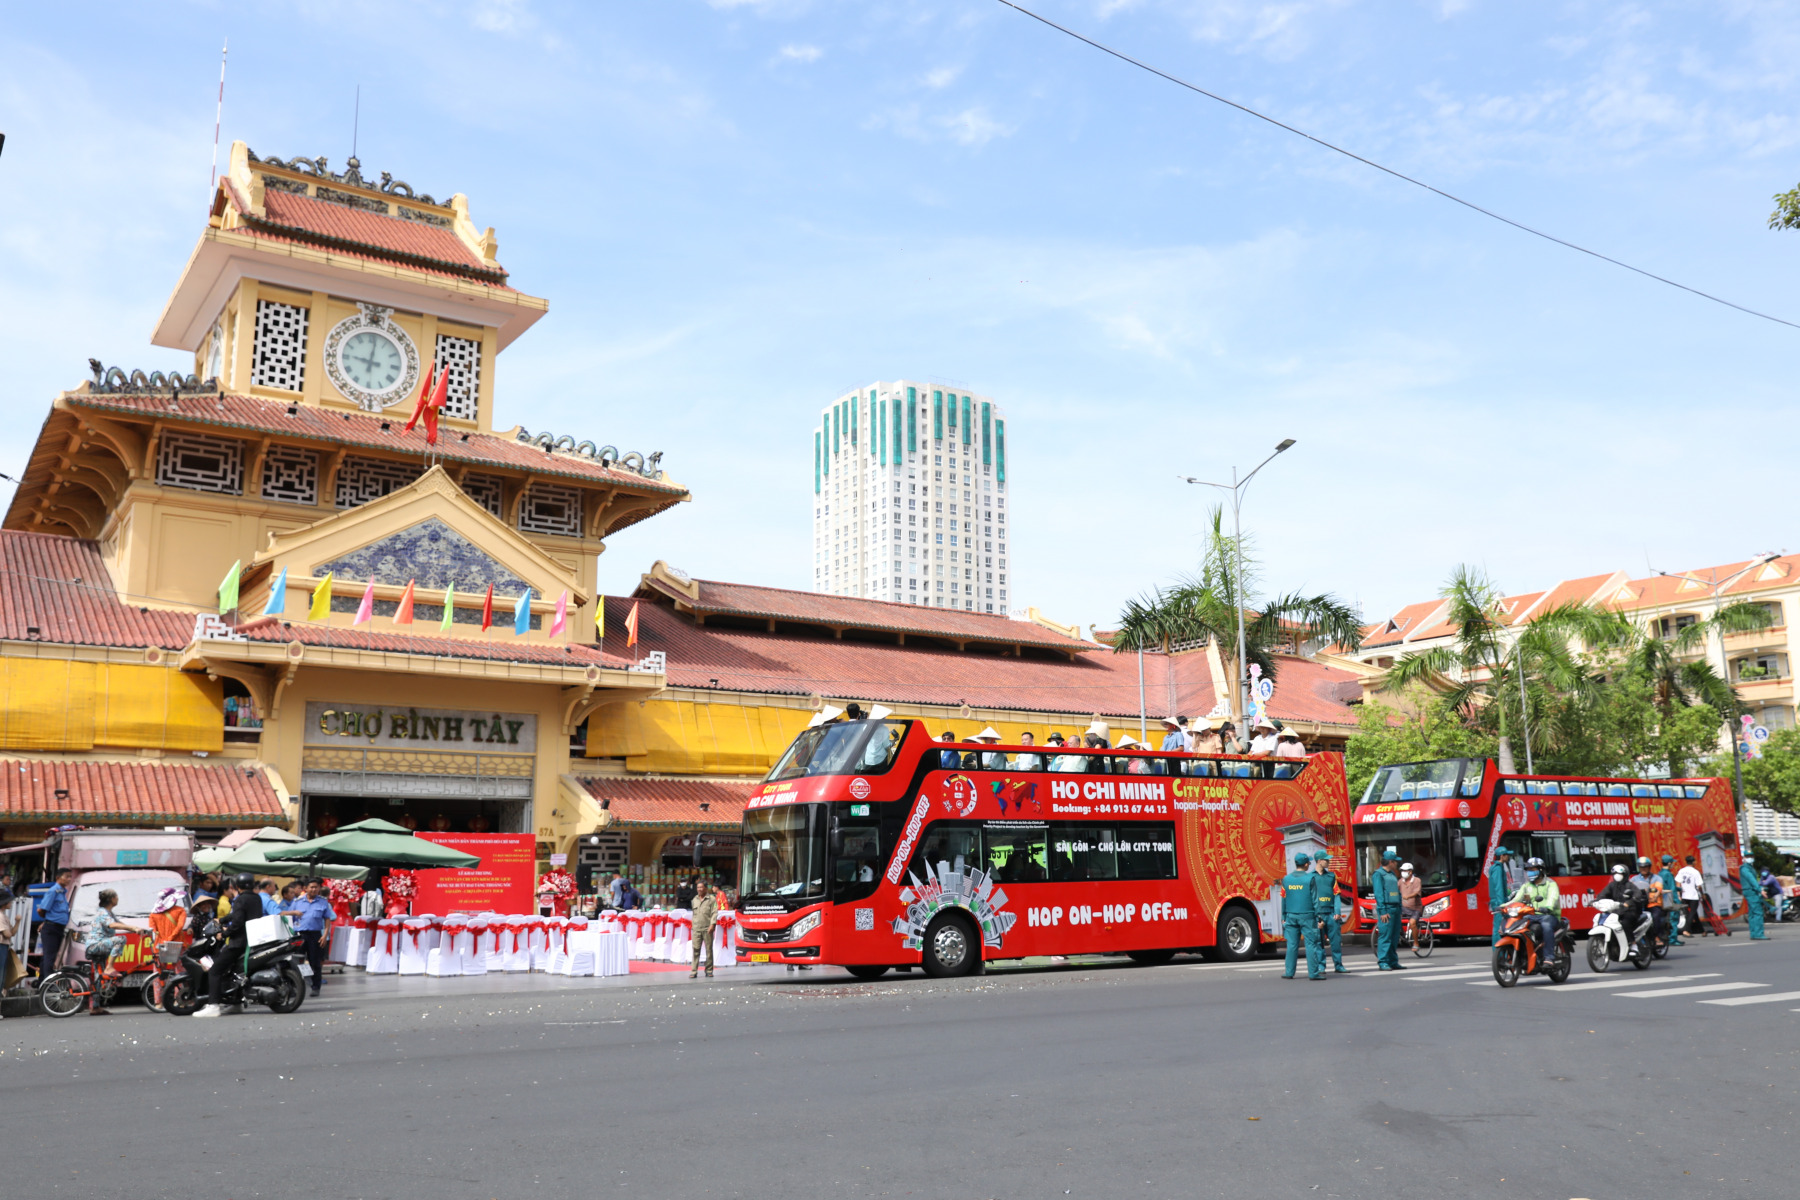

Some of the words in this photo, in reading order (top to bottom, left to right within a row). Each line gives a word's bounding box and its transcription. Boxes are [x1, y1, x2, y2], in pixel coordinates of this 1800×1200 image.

[320, 709, 384, 744] CHỢ
[389, 708, 464, 741] BÌNH
[469, 714, 524, 744] TÂY
[762, 784, 778, 794] CITY
[777, 783, 793, 792] TOUR
[1051, 780, 1080, 800] HO
[1083, 781, 1116, 800] CHI
[1119, 782, 1166, 801] MINH
[1172, 778, 1200, 797] CITY
[1203, 786, 1229, 798] TOUR
[748, 796, 761, 808] HO
[760, 794, 775, 806] CHI
[774, 791, 798, 804] MINH
[1173, 799, 1240, 813] hopon-hopoff.vn
[1052, 803, 1092, 815] Booking:
[1094, 804, 1111, 813] +84
[1113, 804, 1130, 813] 913
[1131, 804, 1142, 813] 67
[1144, 805, 1155, 813] 44
[1157, 805, 1167, 814] 12
[1565, 801, 1582, 815] HO
[1583, 801, 1602, 815] CHI
[1602, 802, 1630, 815] MINH
[1362, 814, 1376, 823] HO
[1376, 812, 1393, 822] CHI
[1395, 810, 1420, 820] MINH
[539, 827, 554, 837] 57A
[887, 856, 903, 884] HOP
[916, 794, 930, 819] OFF
[1056, 840, 1070, 852] SÀI
[1072, 840, 1088, 852] GÒN
[1098, 841, 1114, 853] CHỢ
[1133, 842, 1150, 852] CITY
[1152, 842, 1172, 852] TOUR
[1559, 893, 1579, 908] HOP
[1027, 906, 1063, 927] HOP
[1141, 901, 1188, 922] OFF.VN
